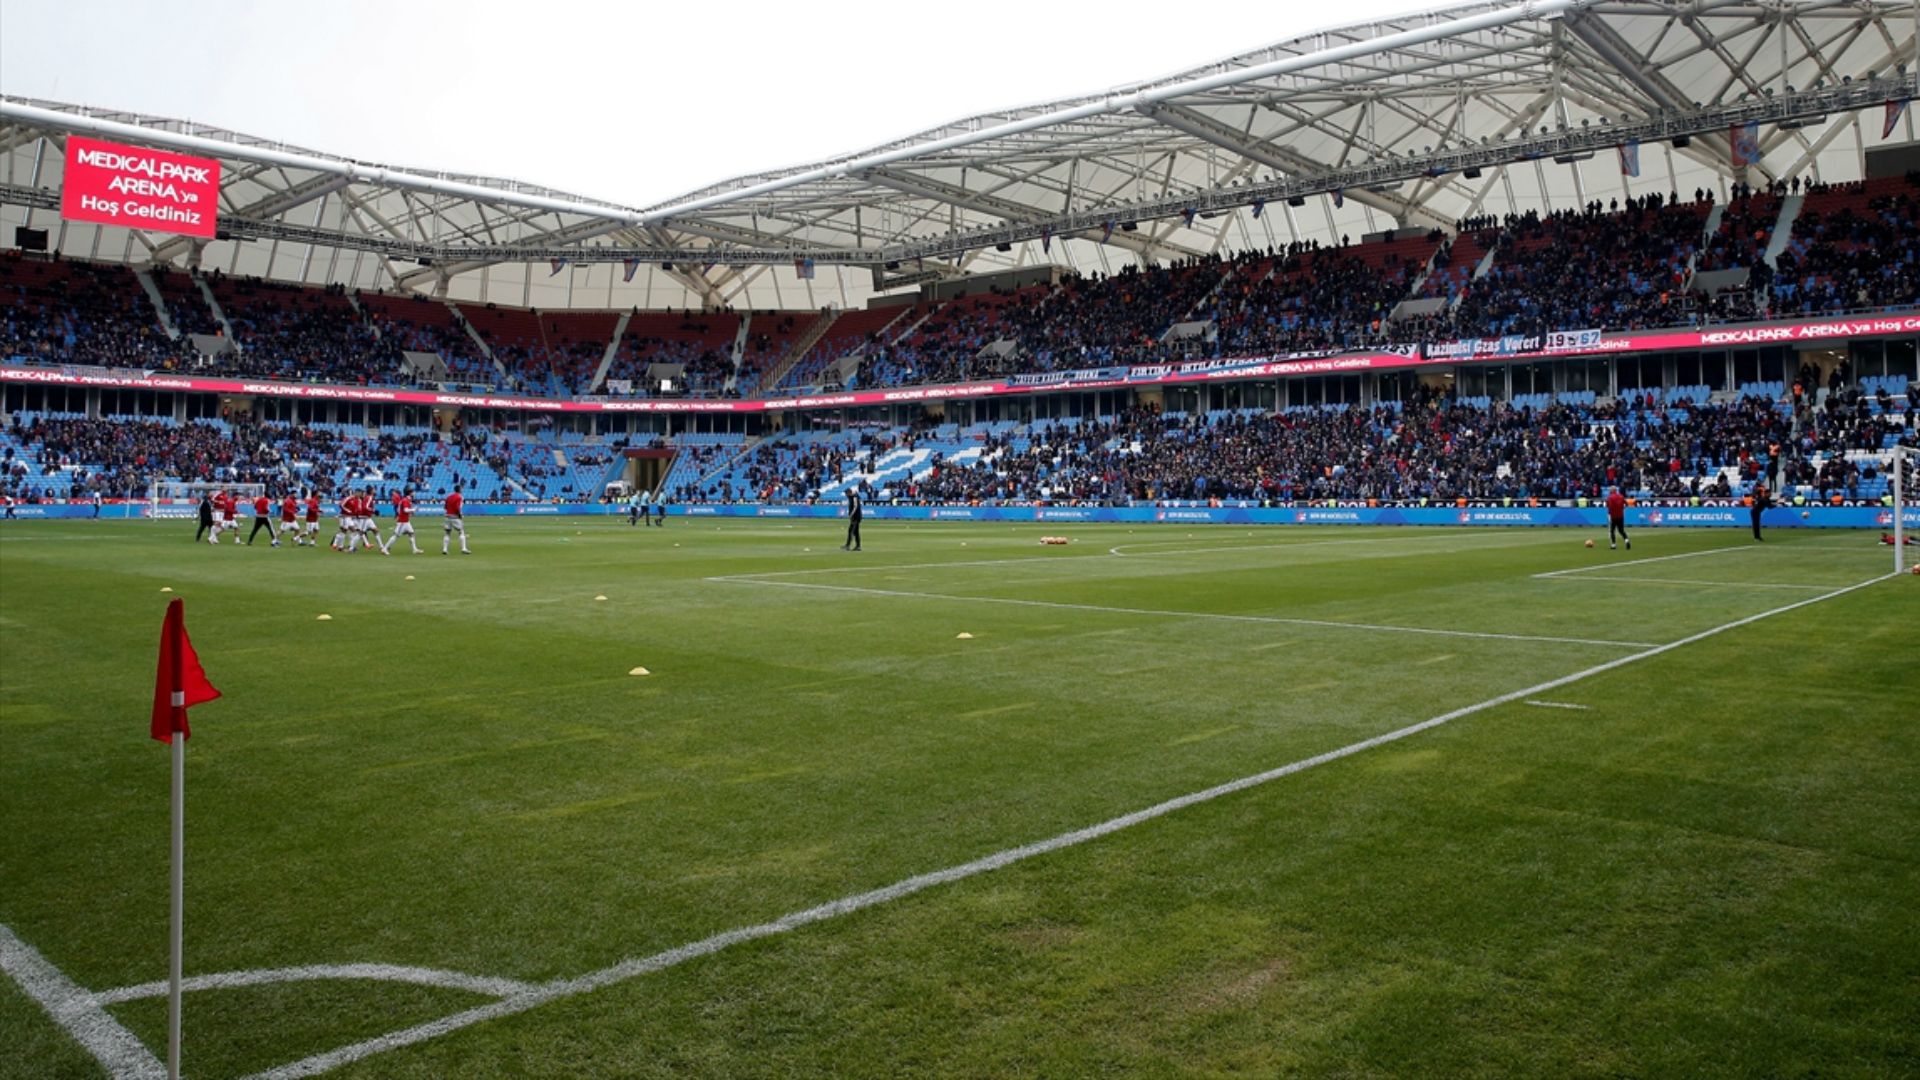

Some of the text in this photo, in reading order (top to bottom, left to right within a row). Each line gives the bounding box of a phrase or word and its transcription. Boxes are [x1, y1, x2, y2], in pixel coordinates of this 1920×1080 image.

[78, 148, 209, 184] MEDICALPARK
[81, 194, 200, 225] Hoş Geldiniz
[1547, 334, 1565, 348] 19
[1701, 328, 1793, 344] MEDICALPARK
[1874, 320, 1901, 332] Hoş
